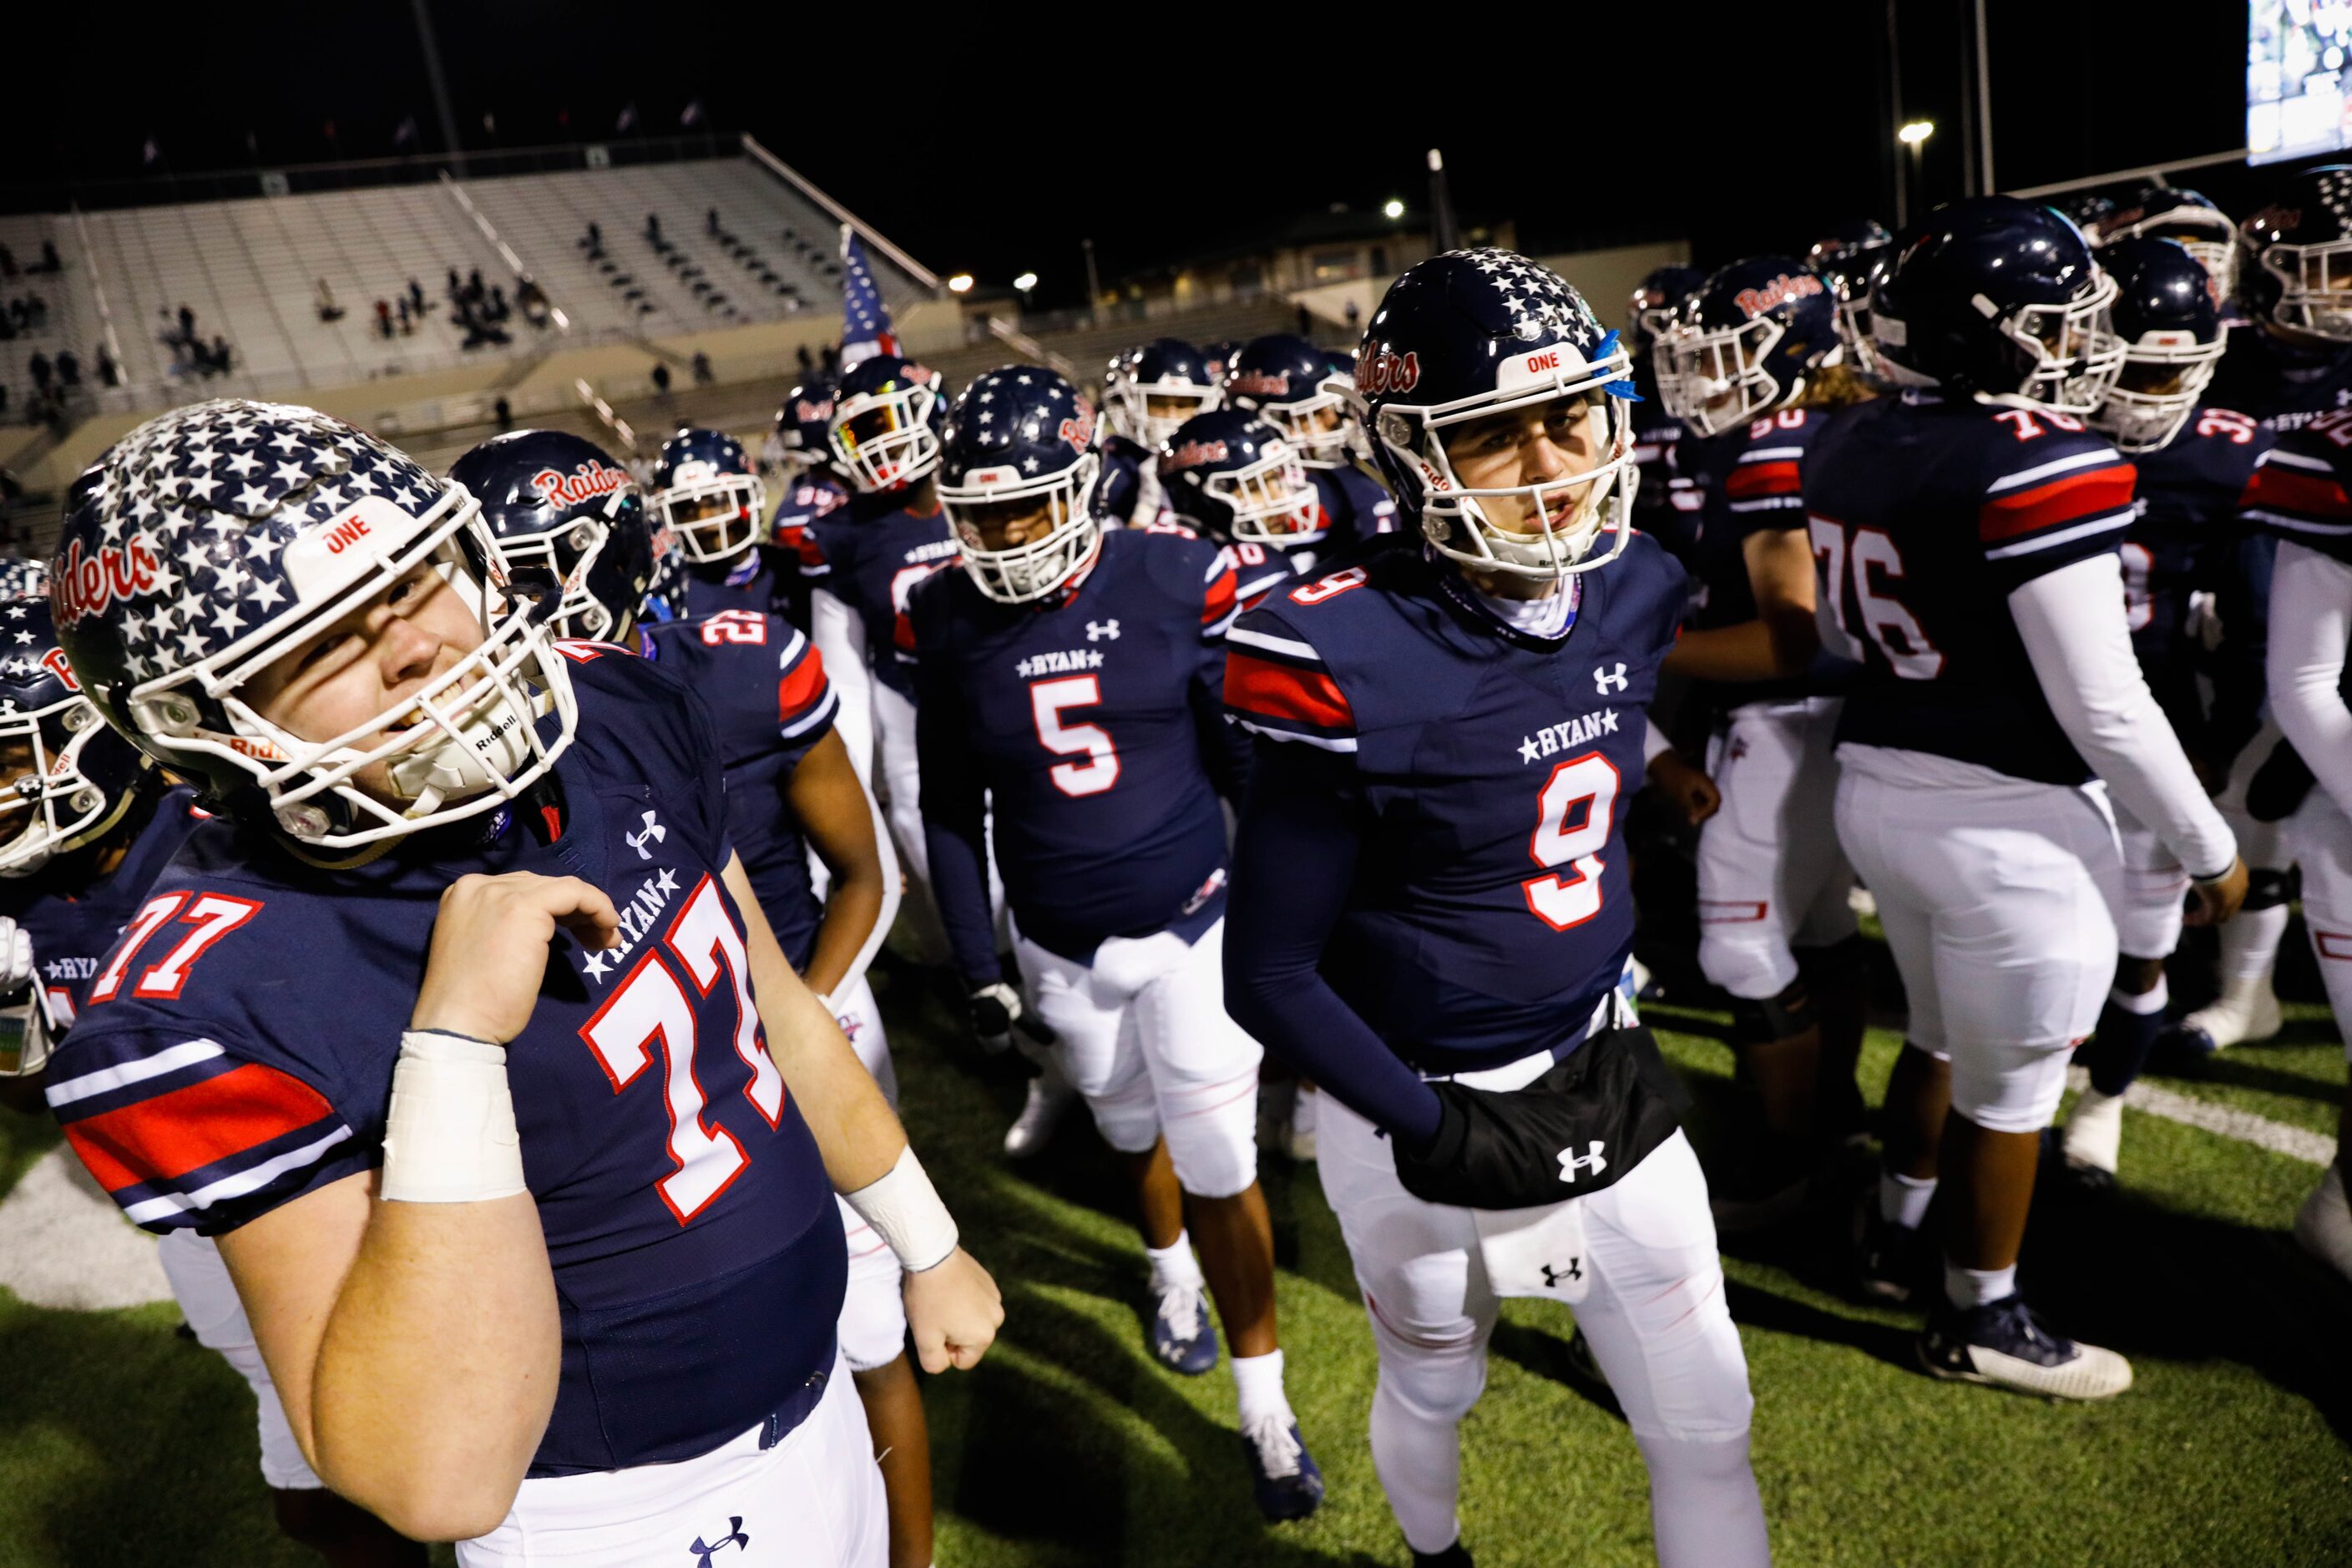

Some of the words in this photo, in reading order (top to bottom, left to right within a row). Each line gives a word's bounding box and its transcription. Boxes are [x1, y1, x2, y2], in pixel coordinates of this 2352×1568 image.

[1527, 352, 1560, 373] ONE
[323, 514, 372, 554] ONE
[1287, 566, 1369, 606] 9
[1808, 512, 1945, 680] 76
[1031, 649, 1087, 676] RYAN
[1029, 673, 1122, 799] 5
[1536, 711, 1602, 757] RYAN
[1520, 751, 1621, 932] 9
[88, 890, 266, 1006] 77
[577, 870, 785, 1227] 77
